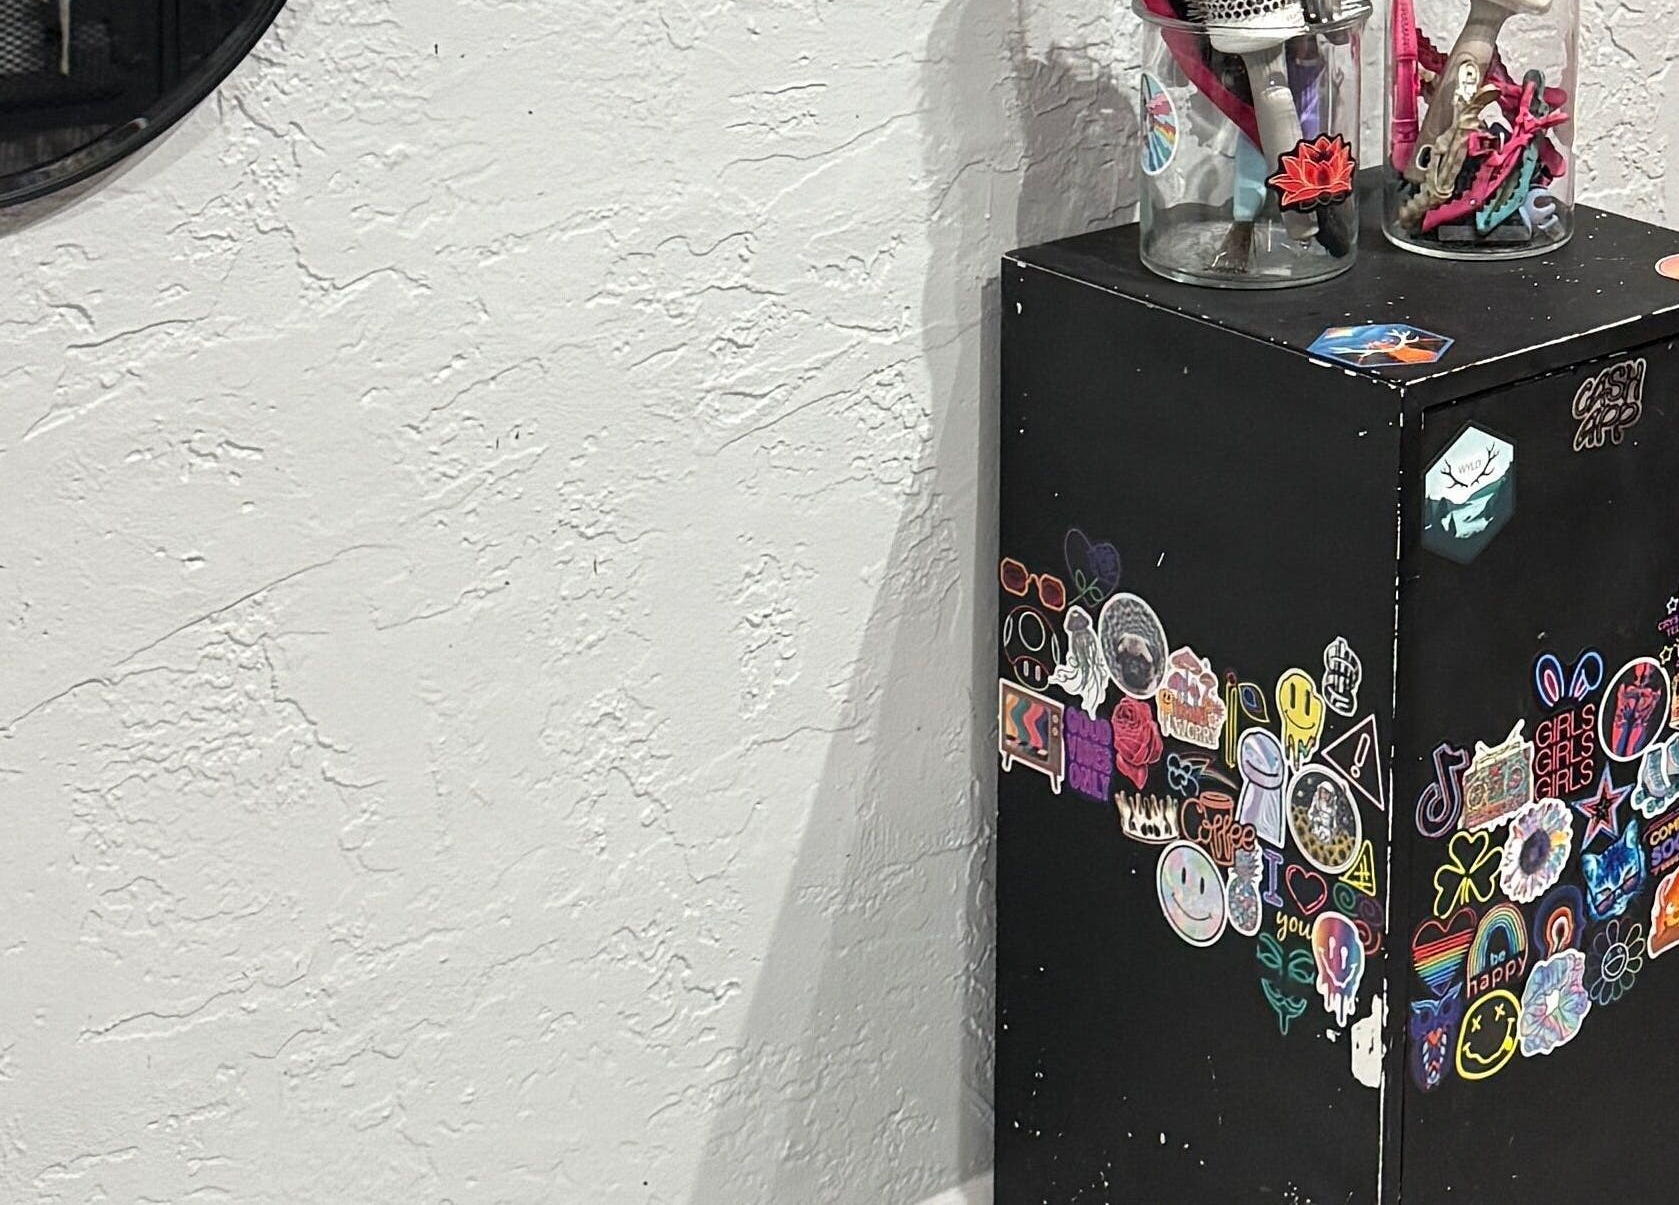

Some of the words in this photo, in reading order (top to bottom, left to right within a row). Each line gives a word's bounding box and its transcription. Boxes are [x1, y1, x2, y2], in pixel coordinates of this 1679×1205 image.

[1573, 358, 1646, 419] CASH
[1574, 401, 1641, 451] APP
[1536, 703, 1596, 748] GIRLS
[1535, 731, 1595, 775] GIRLS
[1534, 759, 1594, 801] GIRLS
[1181, 798, 1256, 859] Coffee
[1276, 911, 1312, 941] you
[1466, 957, 1525, 999] happy
[1489, 950, 1506, 966] be
